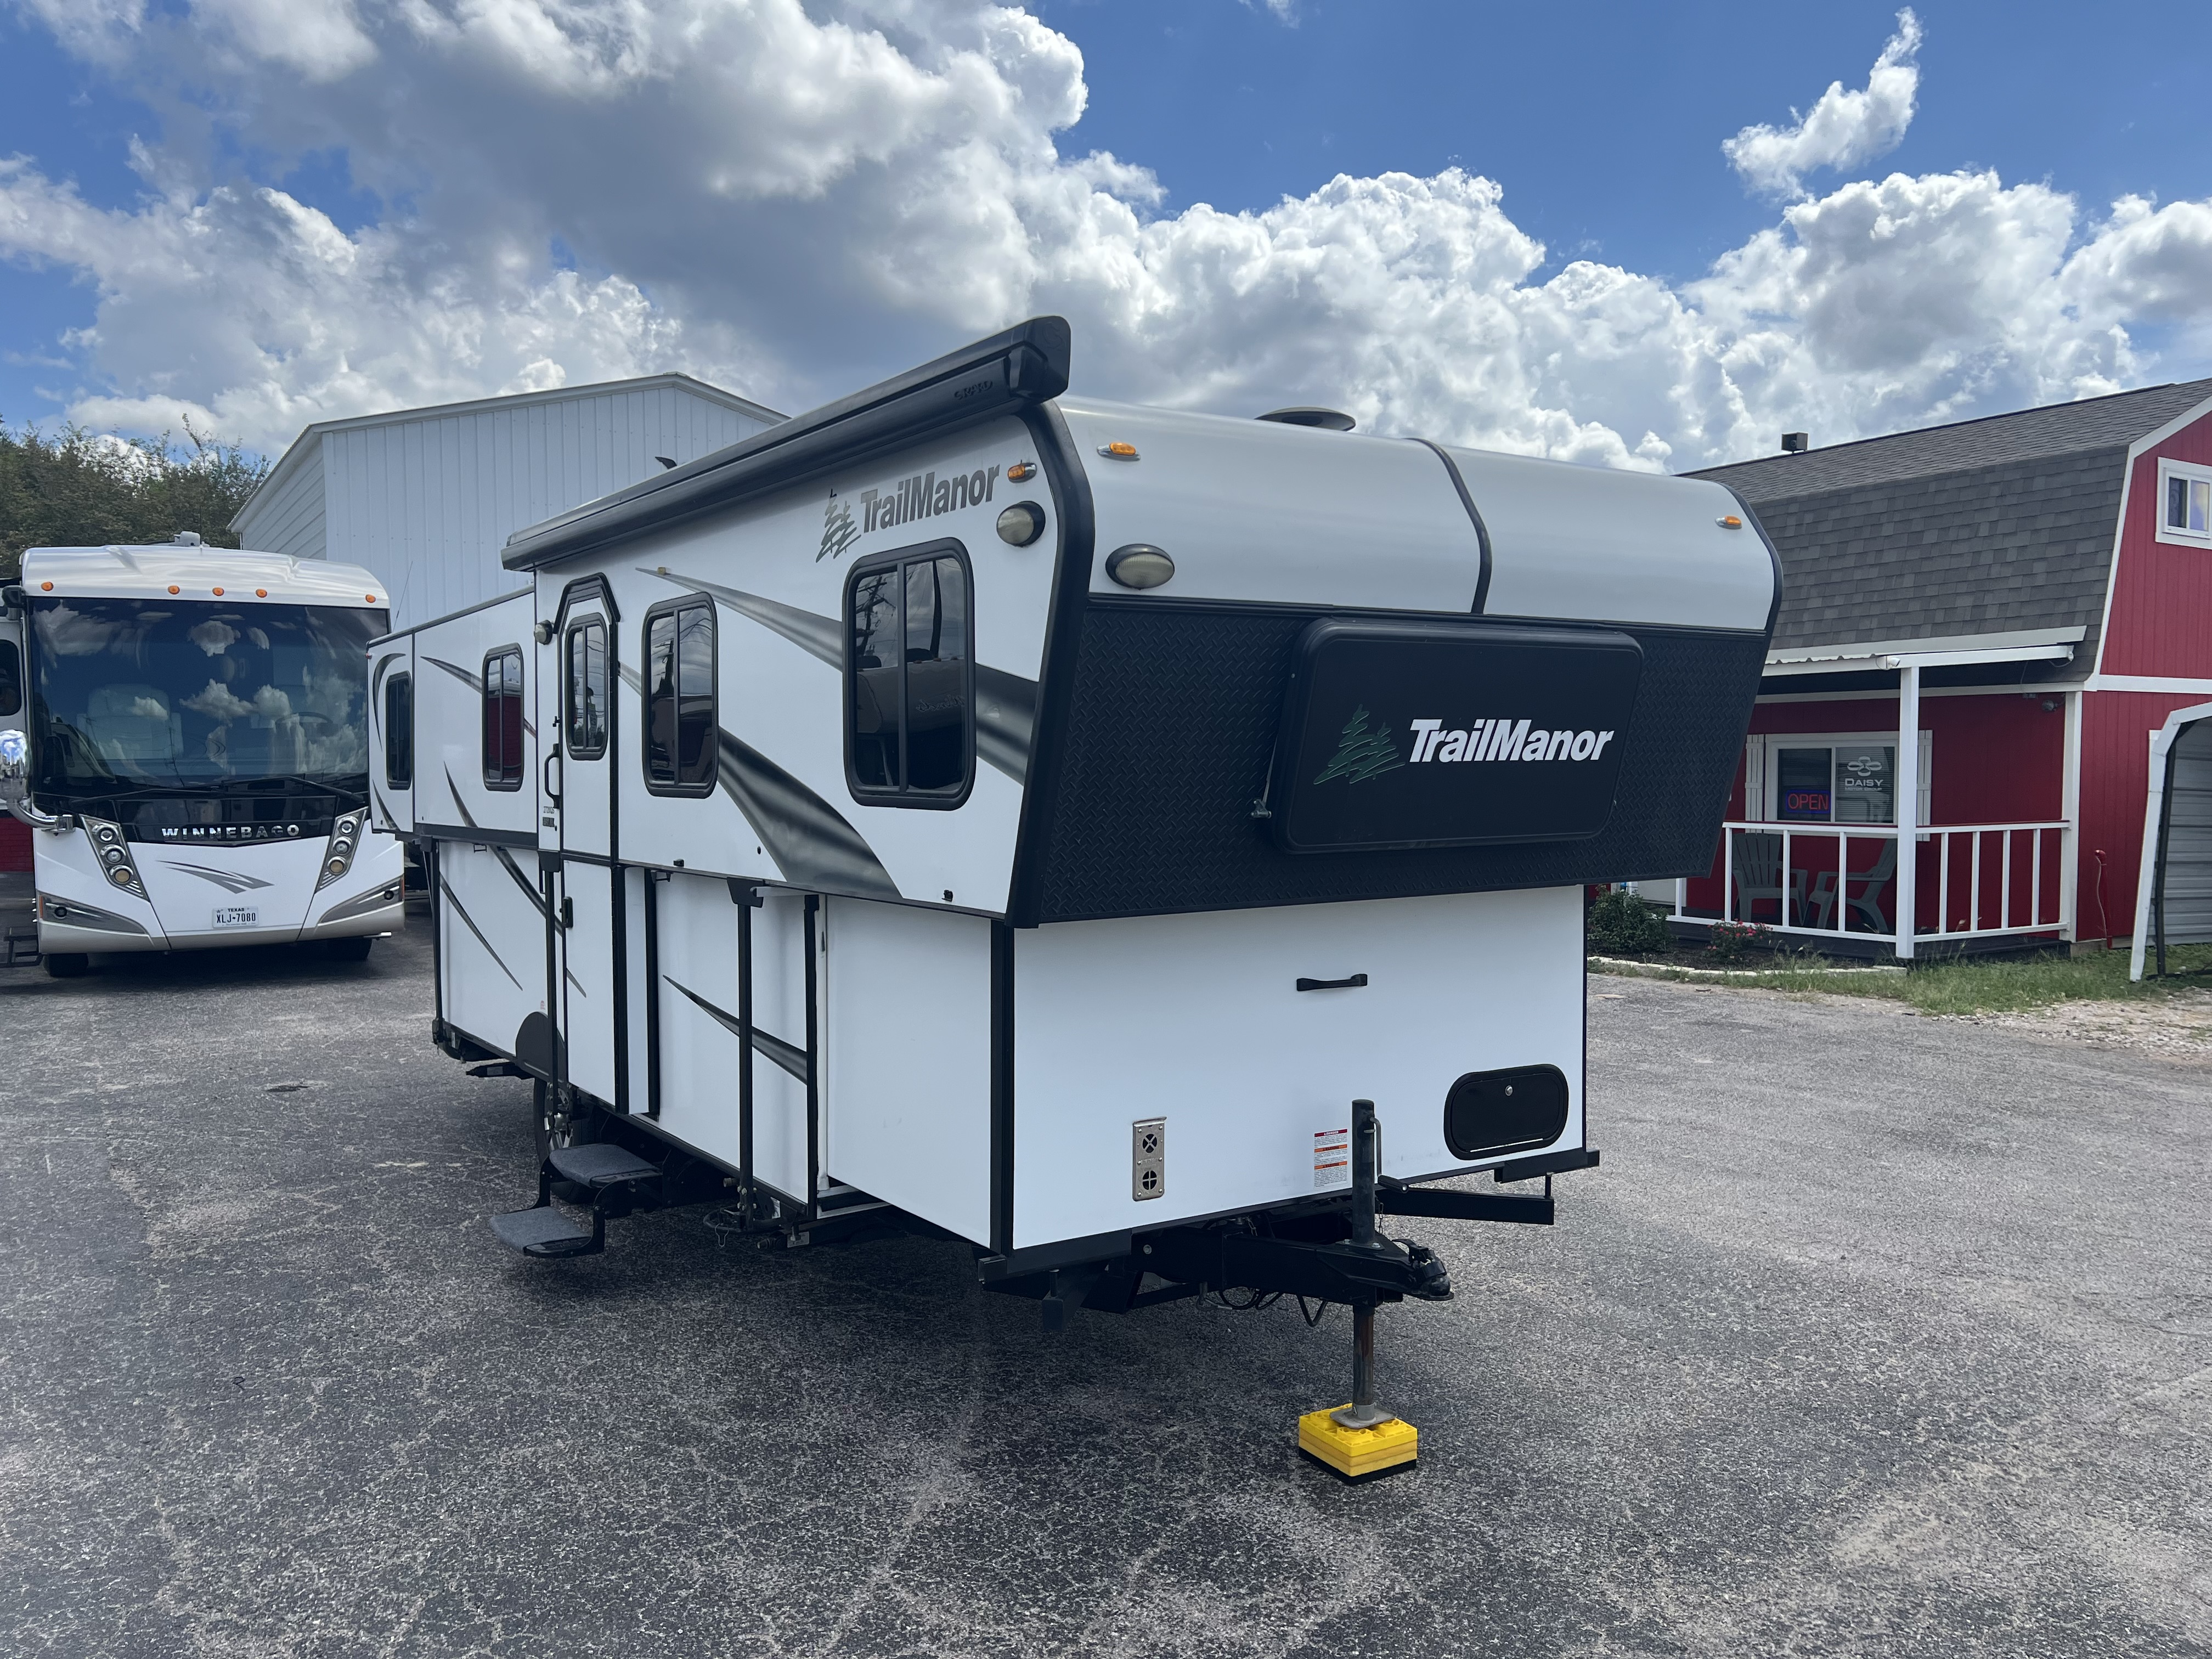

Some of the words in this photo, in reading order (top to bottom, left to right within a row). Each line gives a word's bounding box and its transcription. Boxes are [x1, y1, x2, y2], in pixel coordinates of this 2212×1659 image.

[861, 464, 1000, 533] TrailManor
[1409, 719, 1615, 763] TrailManor
[1845, 778, 1883, 786] DAISY
[1788, 793, 1829, 810] OPEN
[161, 825, 300, 840] WINNEBAGO
